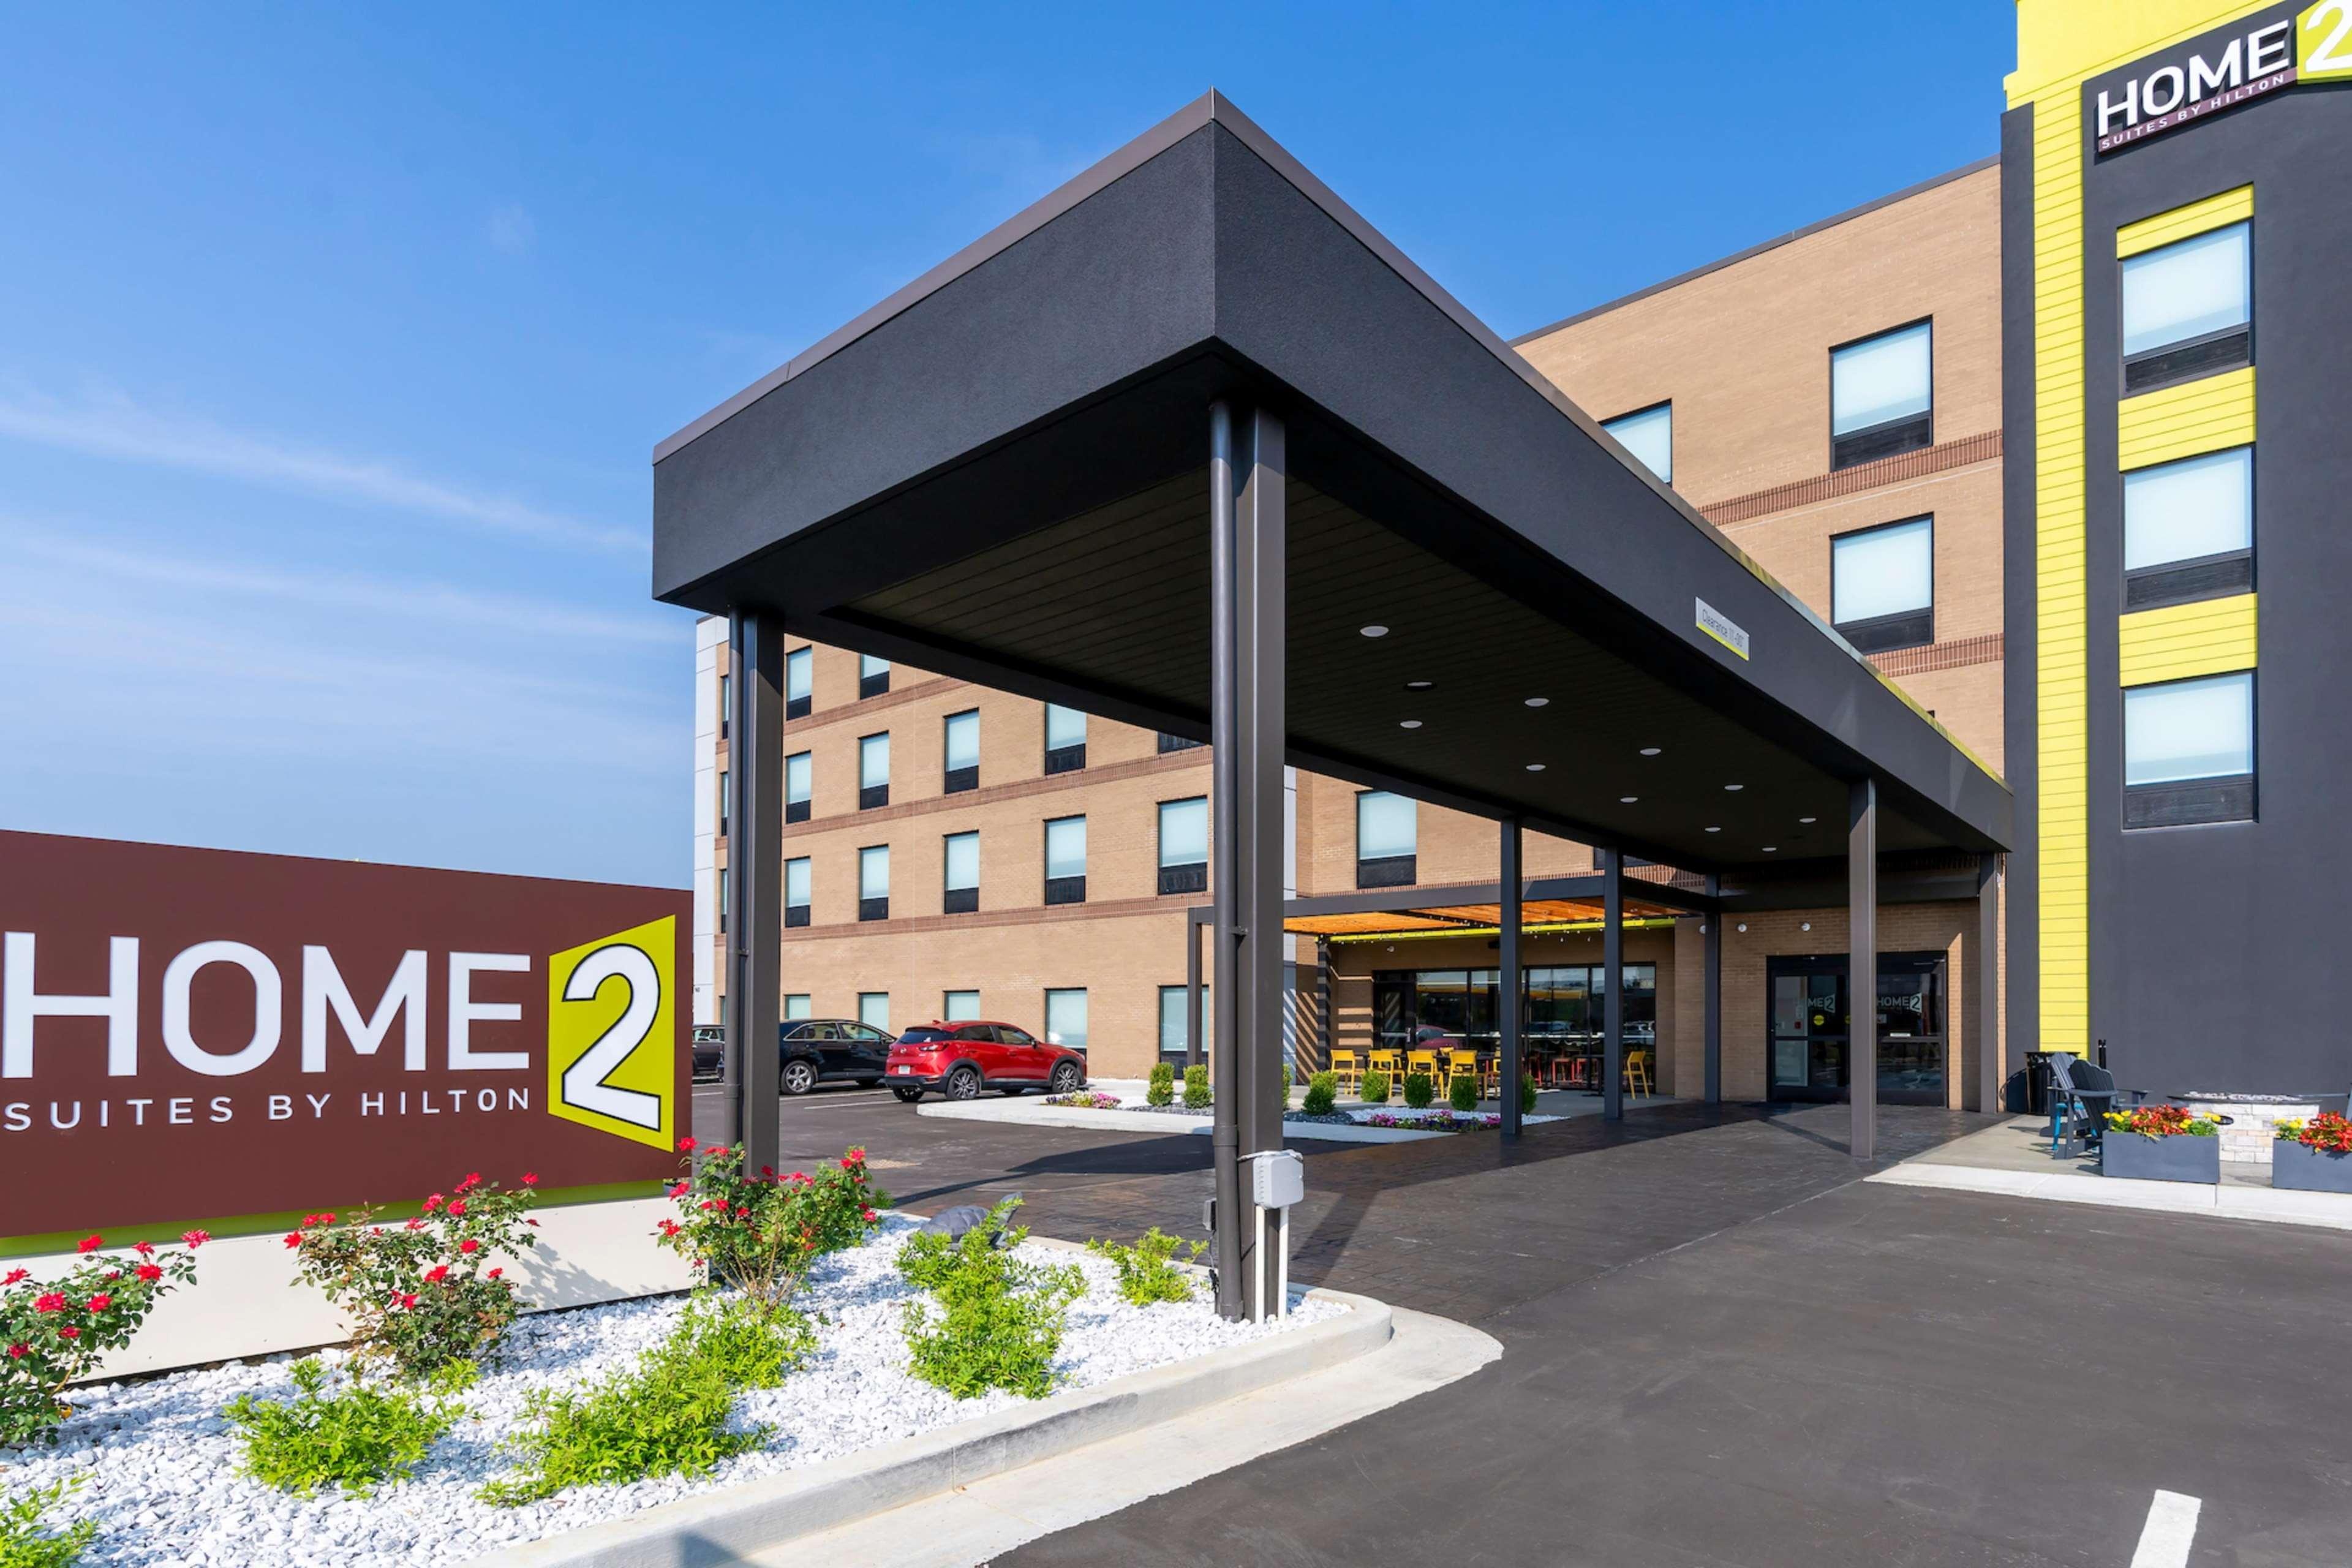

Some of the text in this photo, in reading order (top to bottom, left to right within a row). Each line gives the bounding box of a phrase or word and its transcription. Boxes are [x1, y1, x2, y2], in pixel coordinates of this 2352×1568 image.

[2098, 0, 2352, 137] HOME 2
[2102, 74, 2284, 148] SUITES BY HILTON
[2, 932, 531, 1078] HOME
[4, 1088, 529, 1131] SUITES BY HILTON
